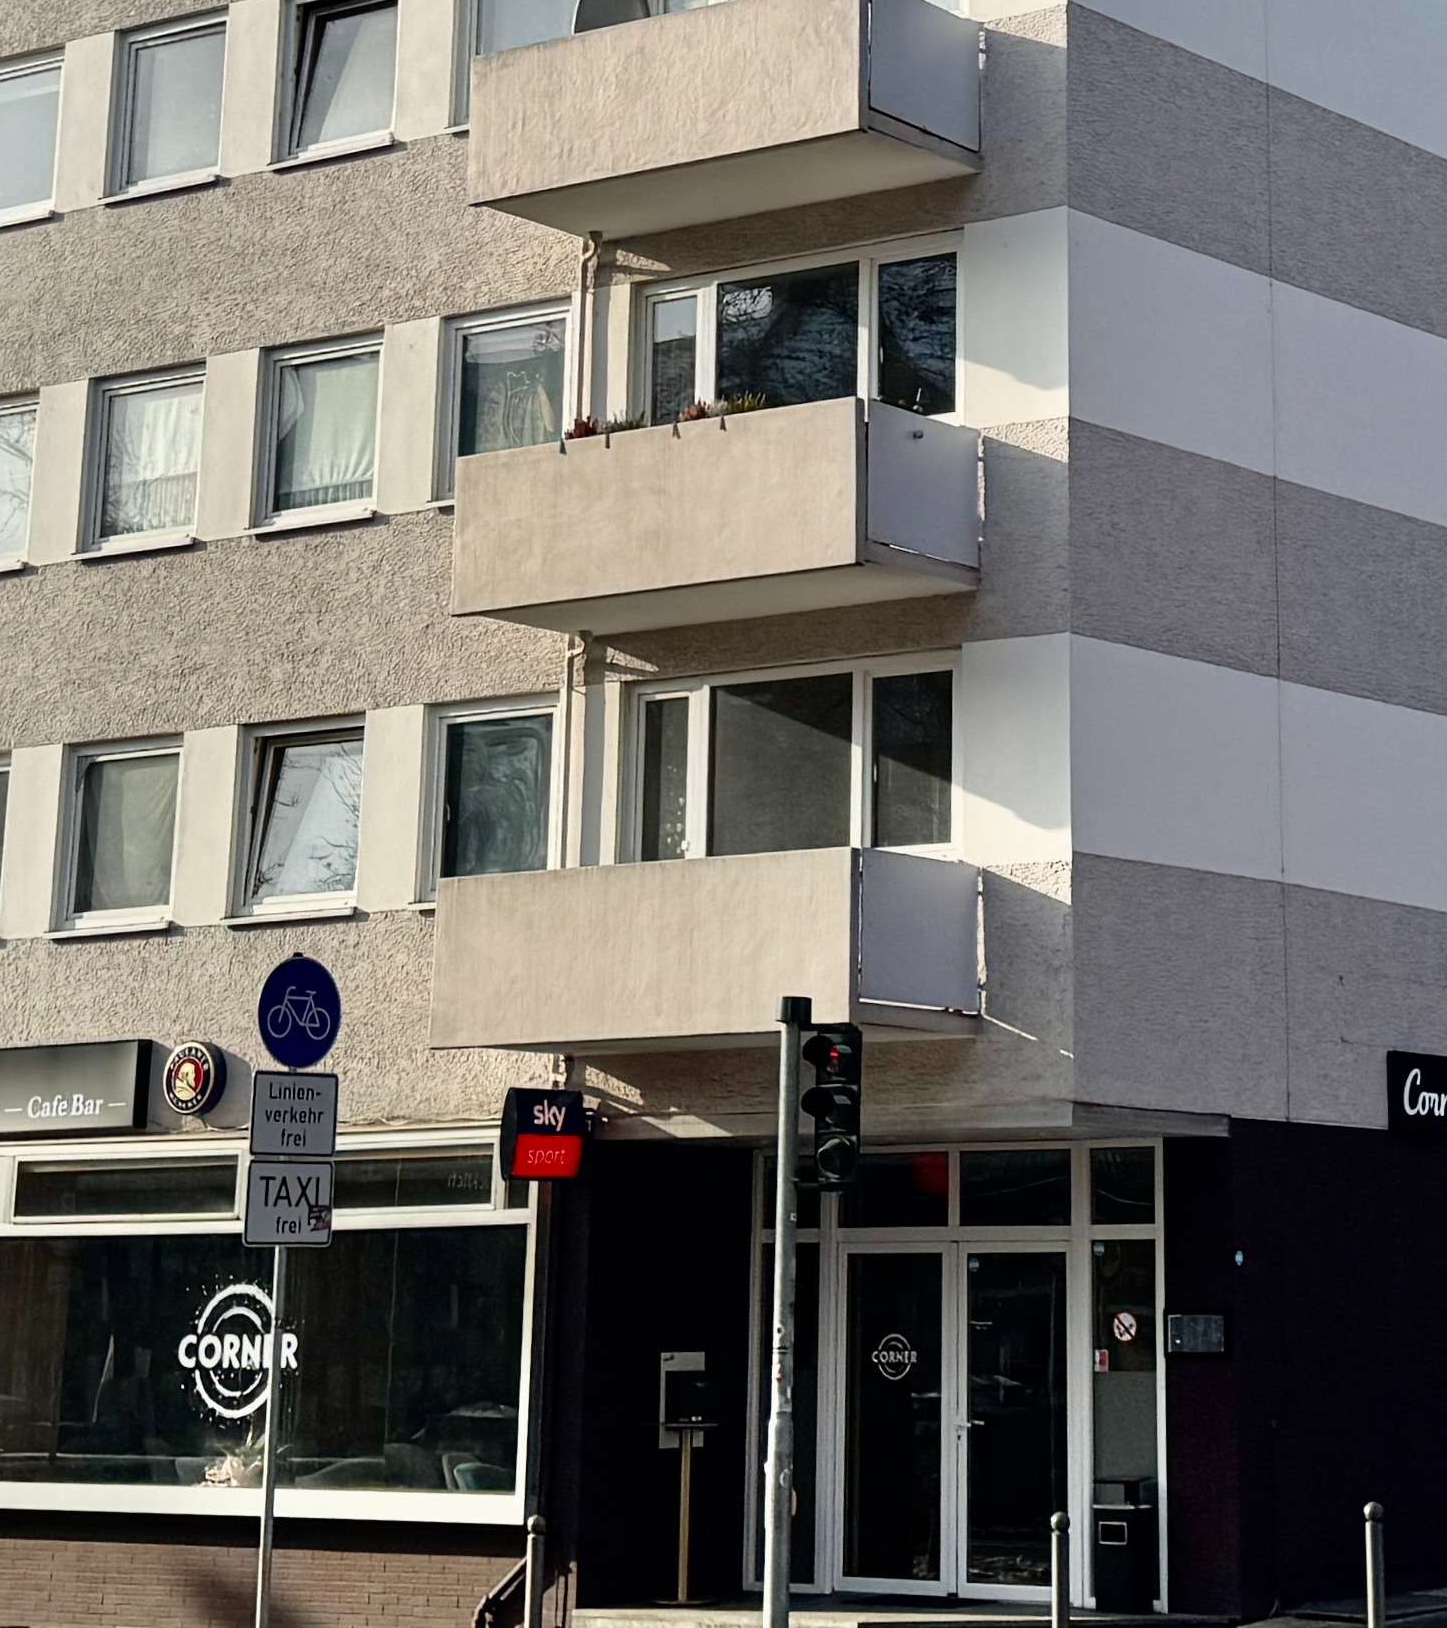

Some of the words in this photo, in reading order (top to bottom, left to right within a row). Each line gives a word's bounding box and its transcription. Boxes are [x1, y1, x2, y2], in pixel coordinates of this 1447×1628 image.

[269, 1081, 322, 1101] Linien-
[70, 1093, 104, 1116] Bar
[265, 1106, 324, 1124] verkehr
[533, 1099, 566, 1132] sky
[281, 1128, 307, 1147] frei
[527, 1149, 568, 1165] sport
[259, 1175, 320, 1208] TAXI
[275, 1216, 302, 1234] frei
[871, 1350, 918, 1364] CORNER
